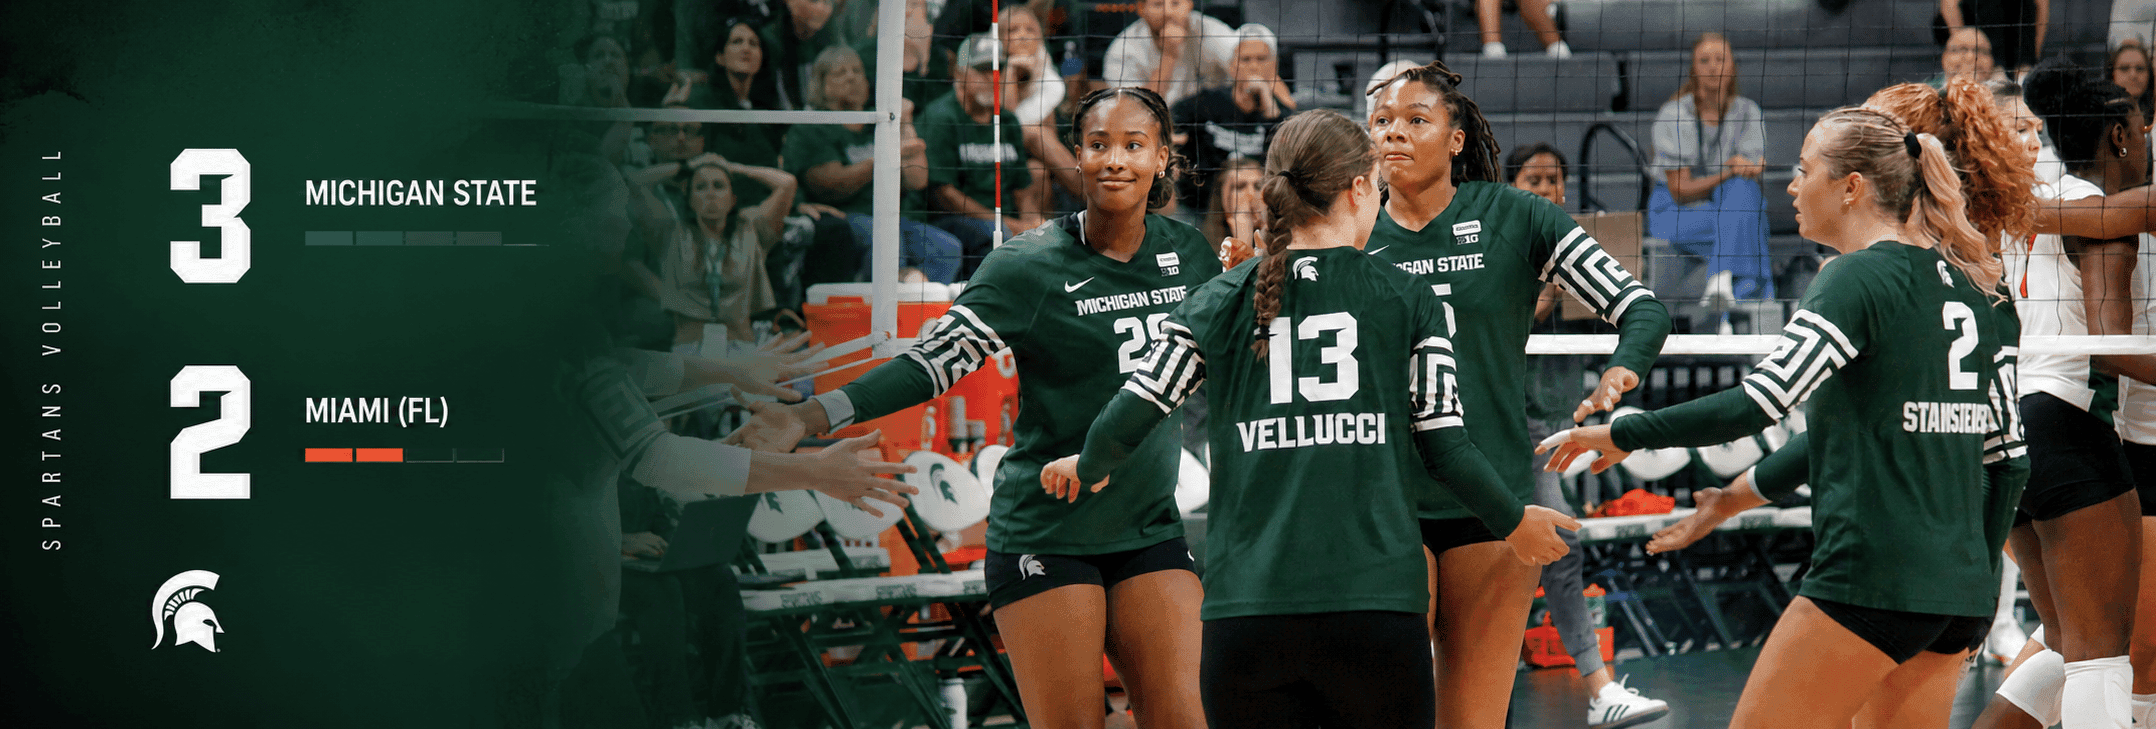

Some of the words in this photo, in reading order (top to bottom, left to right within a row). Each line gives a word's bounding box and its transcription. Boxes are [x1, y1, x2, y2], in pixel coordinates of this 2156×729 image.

[1437, 253, 1485, 273] STATE
[1075, 291, 1150, 317] MICHIGAN
[1267, 311, 1360, 405] 13
[1942, 301, 1979, 390] 2
[1236, 412, 1386, 452] VELLUCCI
